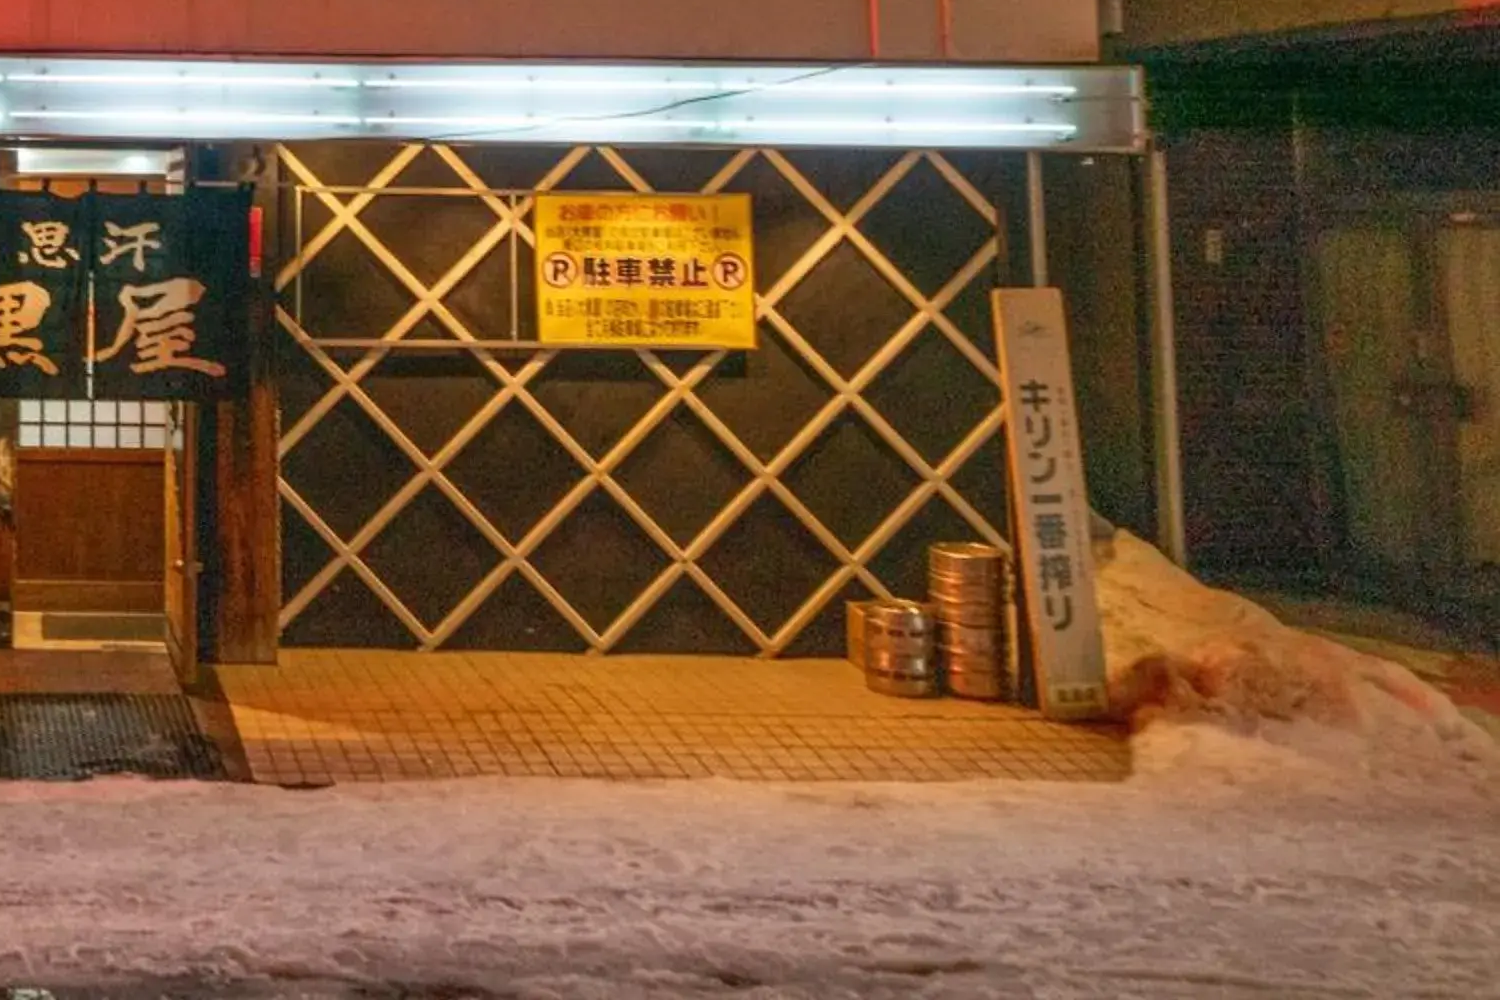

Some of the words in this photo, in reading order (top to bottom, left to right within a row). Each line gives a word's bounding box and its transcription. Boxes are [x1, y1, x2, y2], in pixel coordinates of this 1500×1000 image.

[582, 255, 710, 288] 駐車禁止
[1019, 378, 1074, 632] キリン一番搾り
